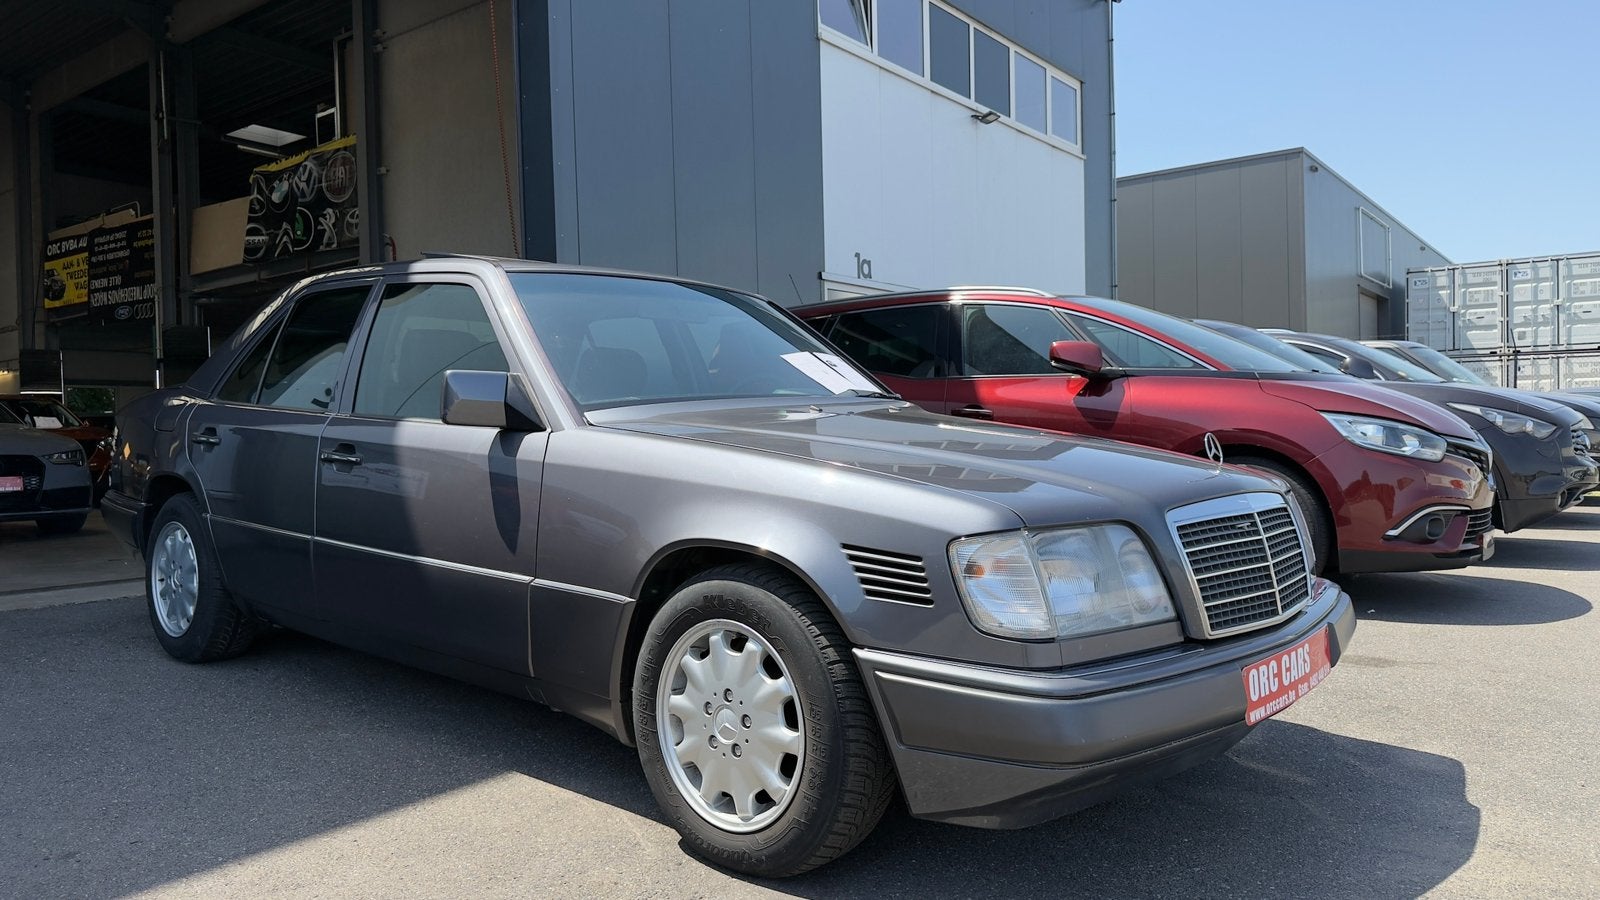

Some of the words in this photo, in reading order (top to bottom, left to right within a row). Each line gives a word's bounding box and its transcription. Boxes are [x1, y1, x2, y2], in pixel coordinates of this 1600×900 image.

[47, 243, 60, 256] ORC
[62, 238, 77, 252] BVBA
[854, 252, 872, 279] 1a
[1248, 660, 1279, 702] ORC
[1281, 644, 1310, 686] CARS
